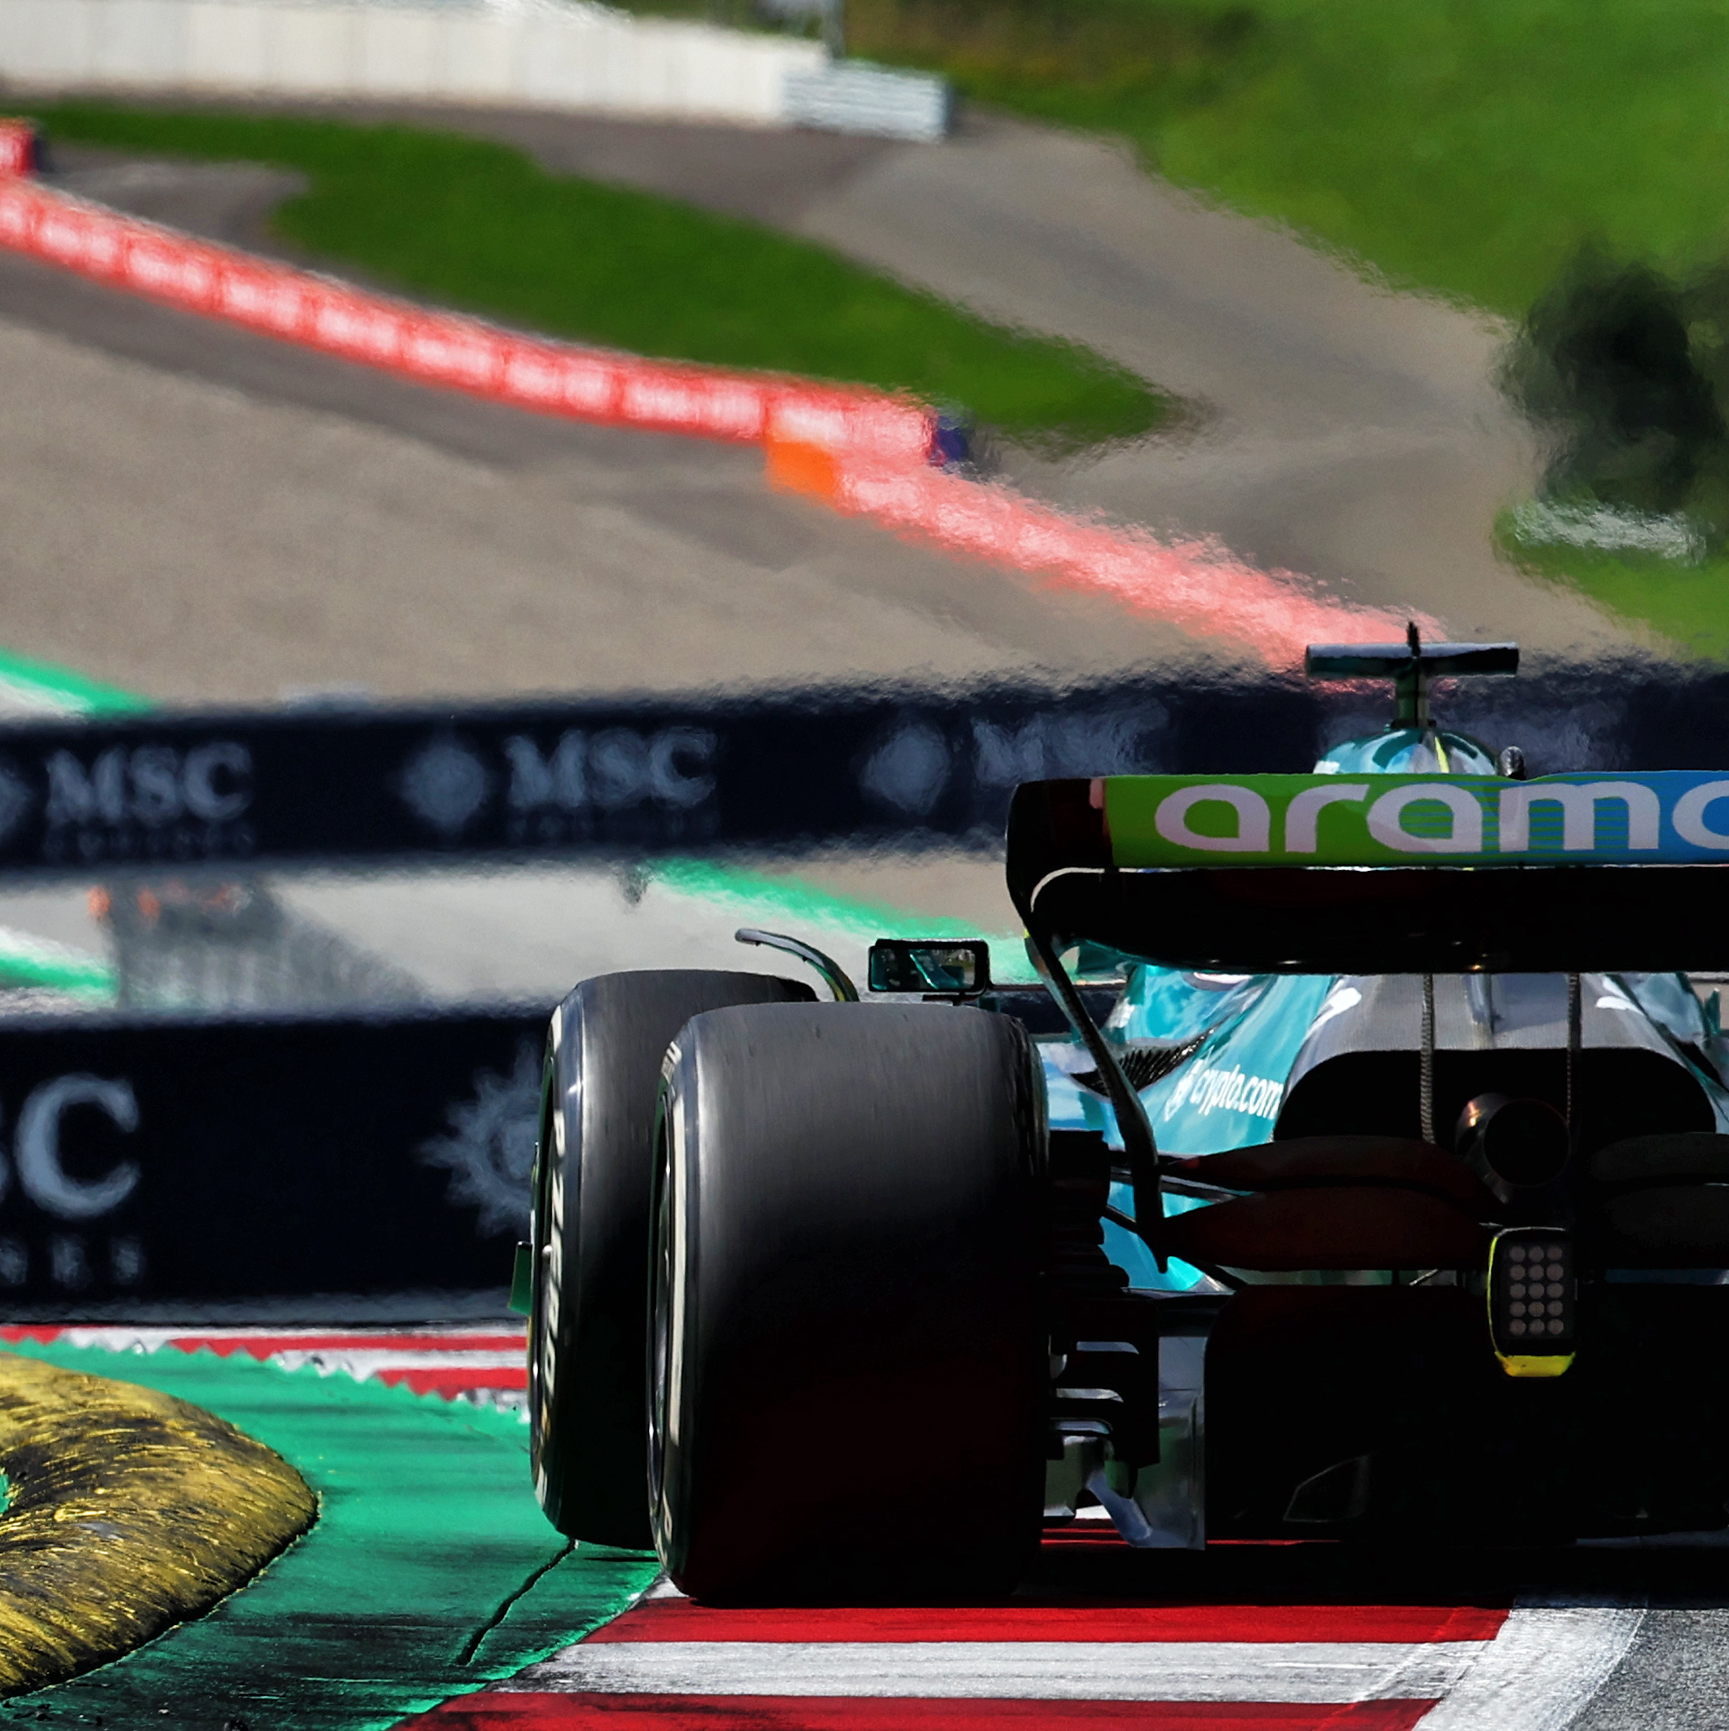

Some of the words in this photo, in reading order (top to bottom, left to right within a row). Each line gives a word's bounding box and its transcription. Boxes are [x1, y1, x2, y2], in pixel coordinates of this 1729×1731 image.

[44, 742, 254, 824] MSC
[504, 726, 717, 809] MSC
[1188, 1064, 1285, 1120] crypto.com
